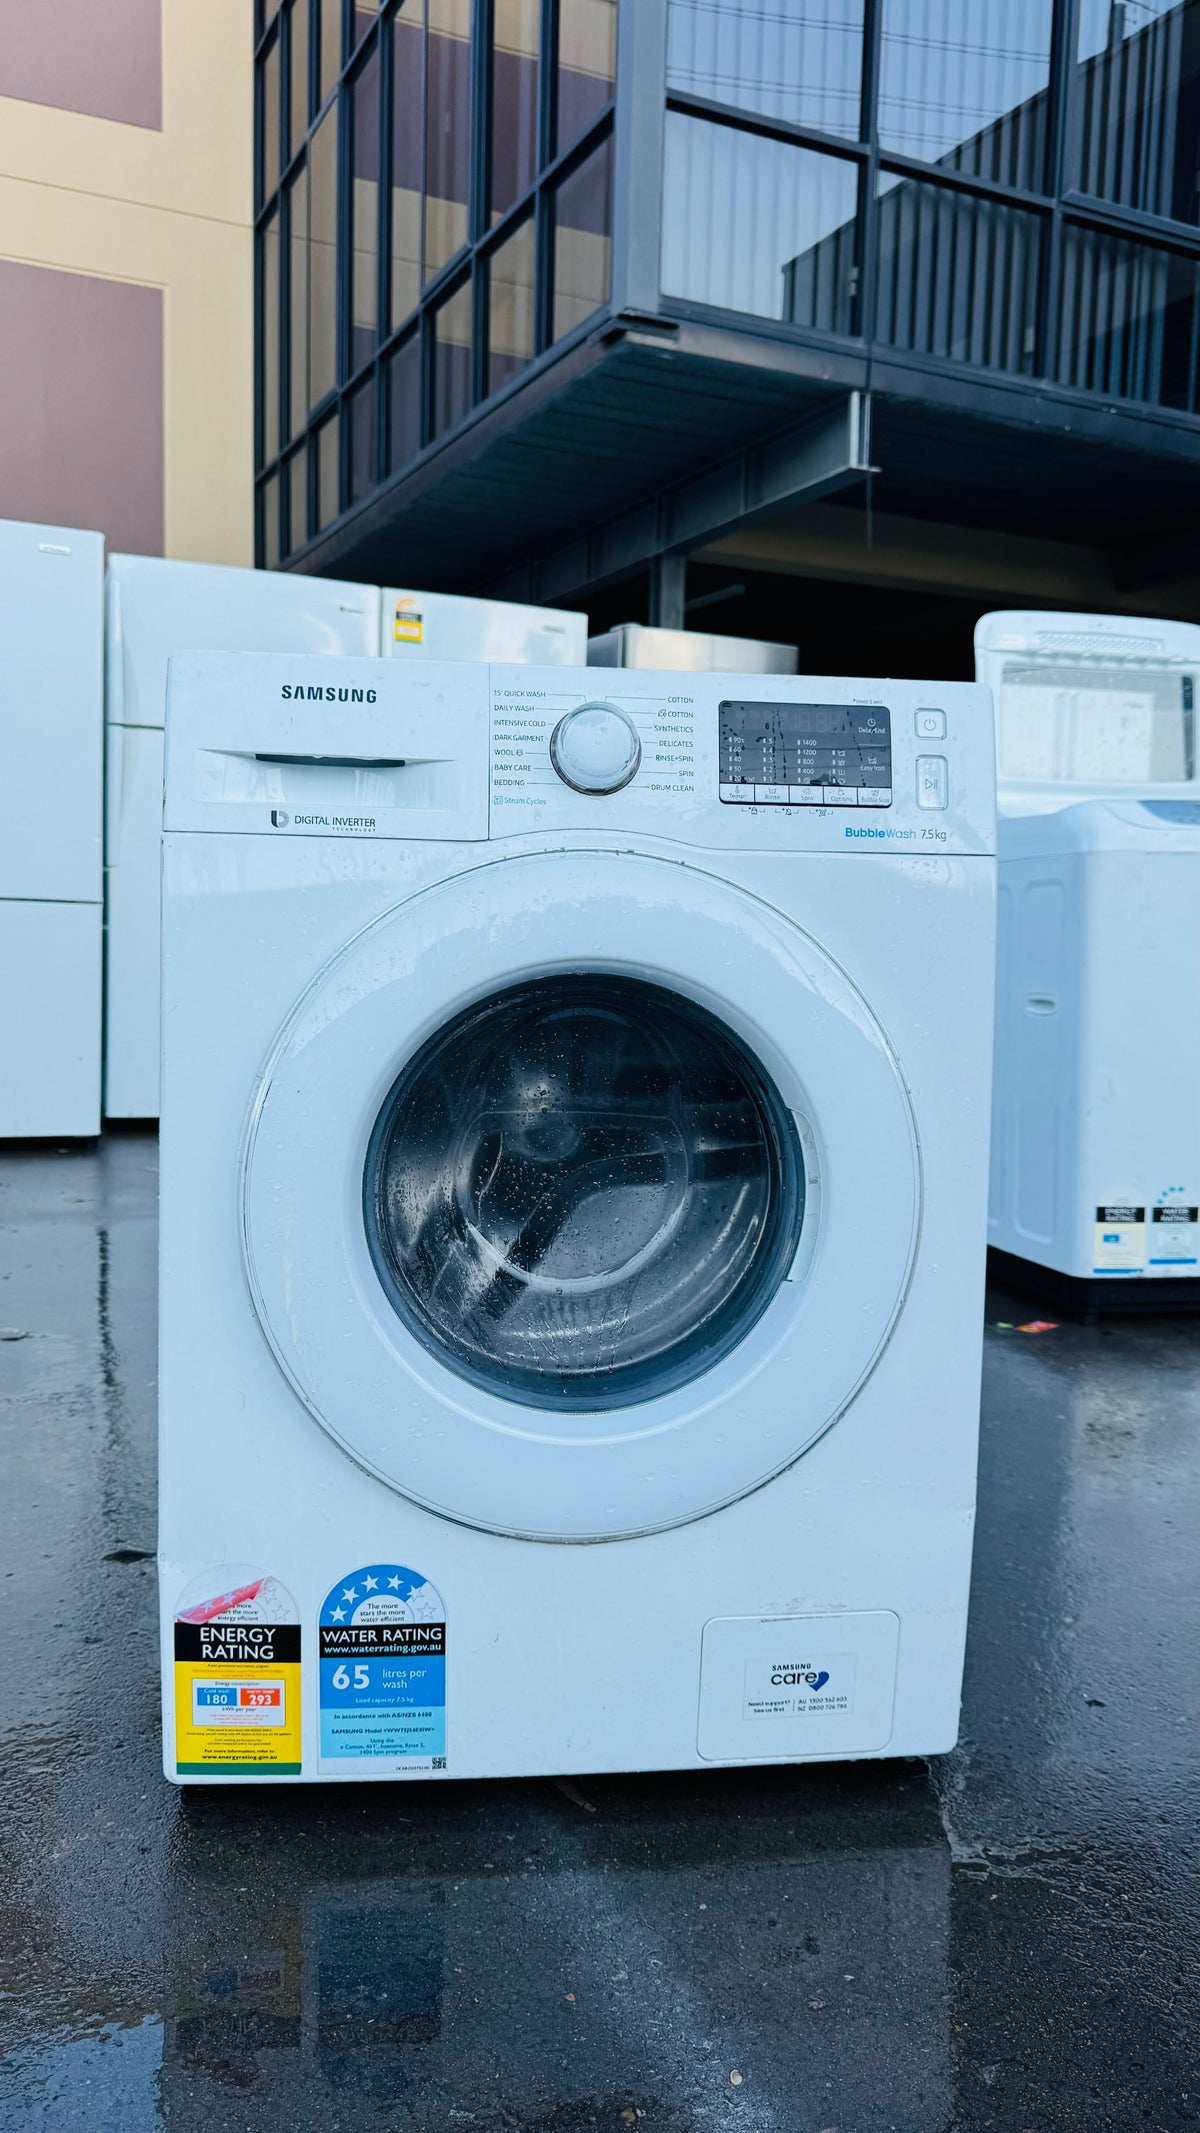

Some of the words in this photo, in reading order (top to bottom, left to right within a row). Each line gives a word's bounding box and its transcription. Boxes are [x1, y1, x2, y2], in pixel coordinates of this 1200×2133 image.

[281, 684, 377, 703] SAMSUNG
[494, 719, 528, 727] INTENSIVE
[654, 725, 694, 733] SYNTHETICS
[659, 740, 694, 748] DELICATES
[655, 755, 694, 763] RINSE+SPIN
[494, 779, 525, 787] BEDDING
[672, 784, 694, 792] CLEAN
[527, 797, 546, 806] Cycles
[294, 815, 330, 825] DIGITAL
[332, 817, 376, 827] INVERTER
[200, 1627, 276, 1643] ENERGY
[323, 1630, 378, 1643] WATER
[382, 1627, 442, 1642] RATING
[202, 1644, 274, 1660] RATING
[324, 1643, 442, 1654] www.waterrating.gov.au
[772, 1663, 811, 1671] SAMSUNG
[332, 1664, 370, 1690] 65
[382, 1668, 407, 1678] litres
[409, 1670, 427, 1680] per
[770, 1671, 818, 1686] care
[382, 1680, 408, 1689] wash
[206, 1694, 228, 1705] 180
[249, 1694, 272, 1706] 293
